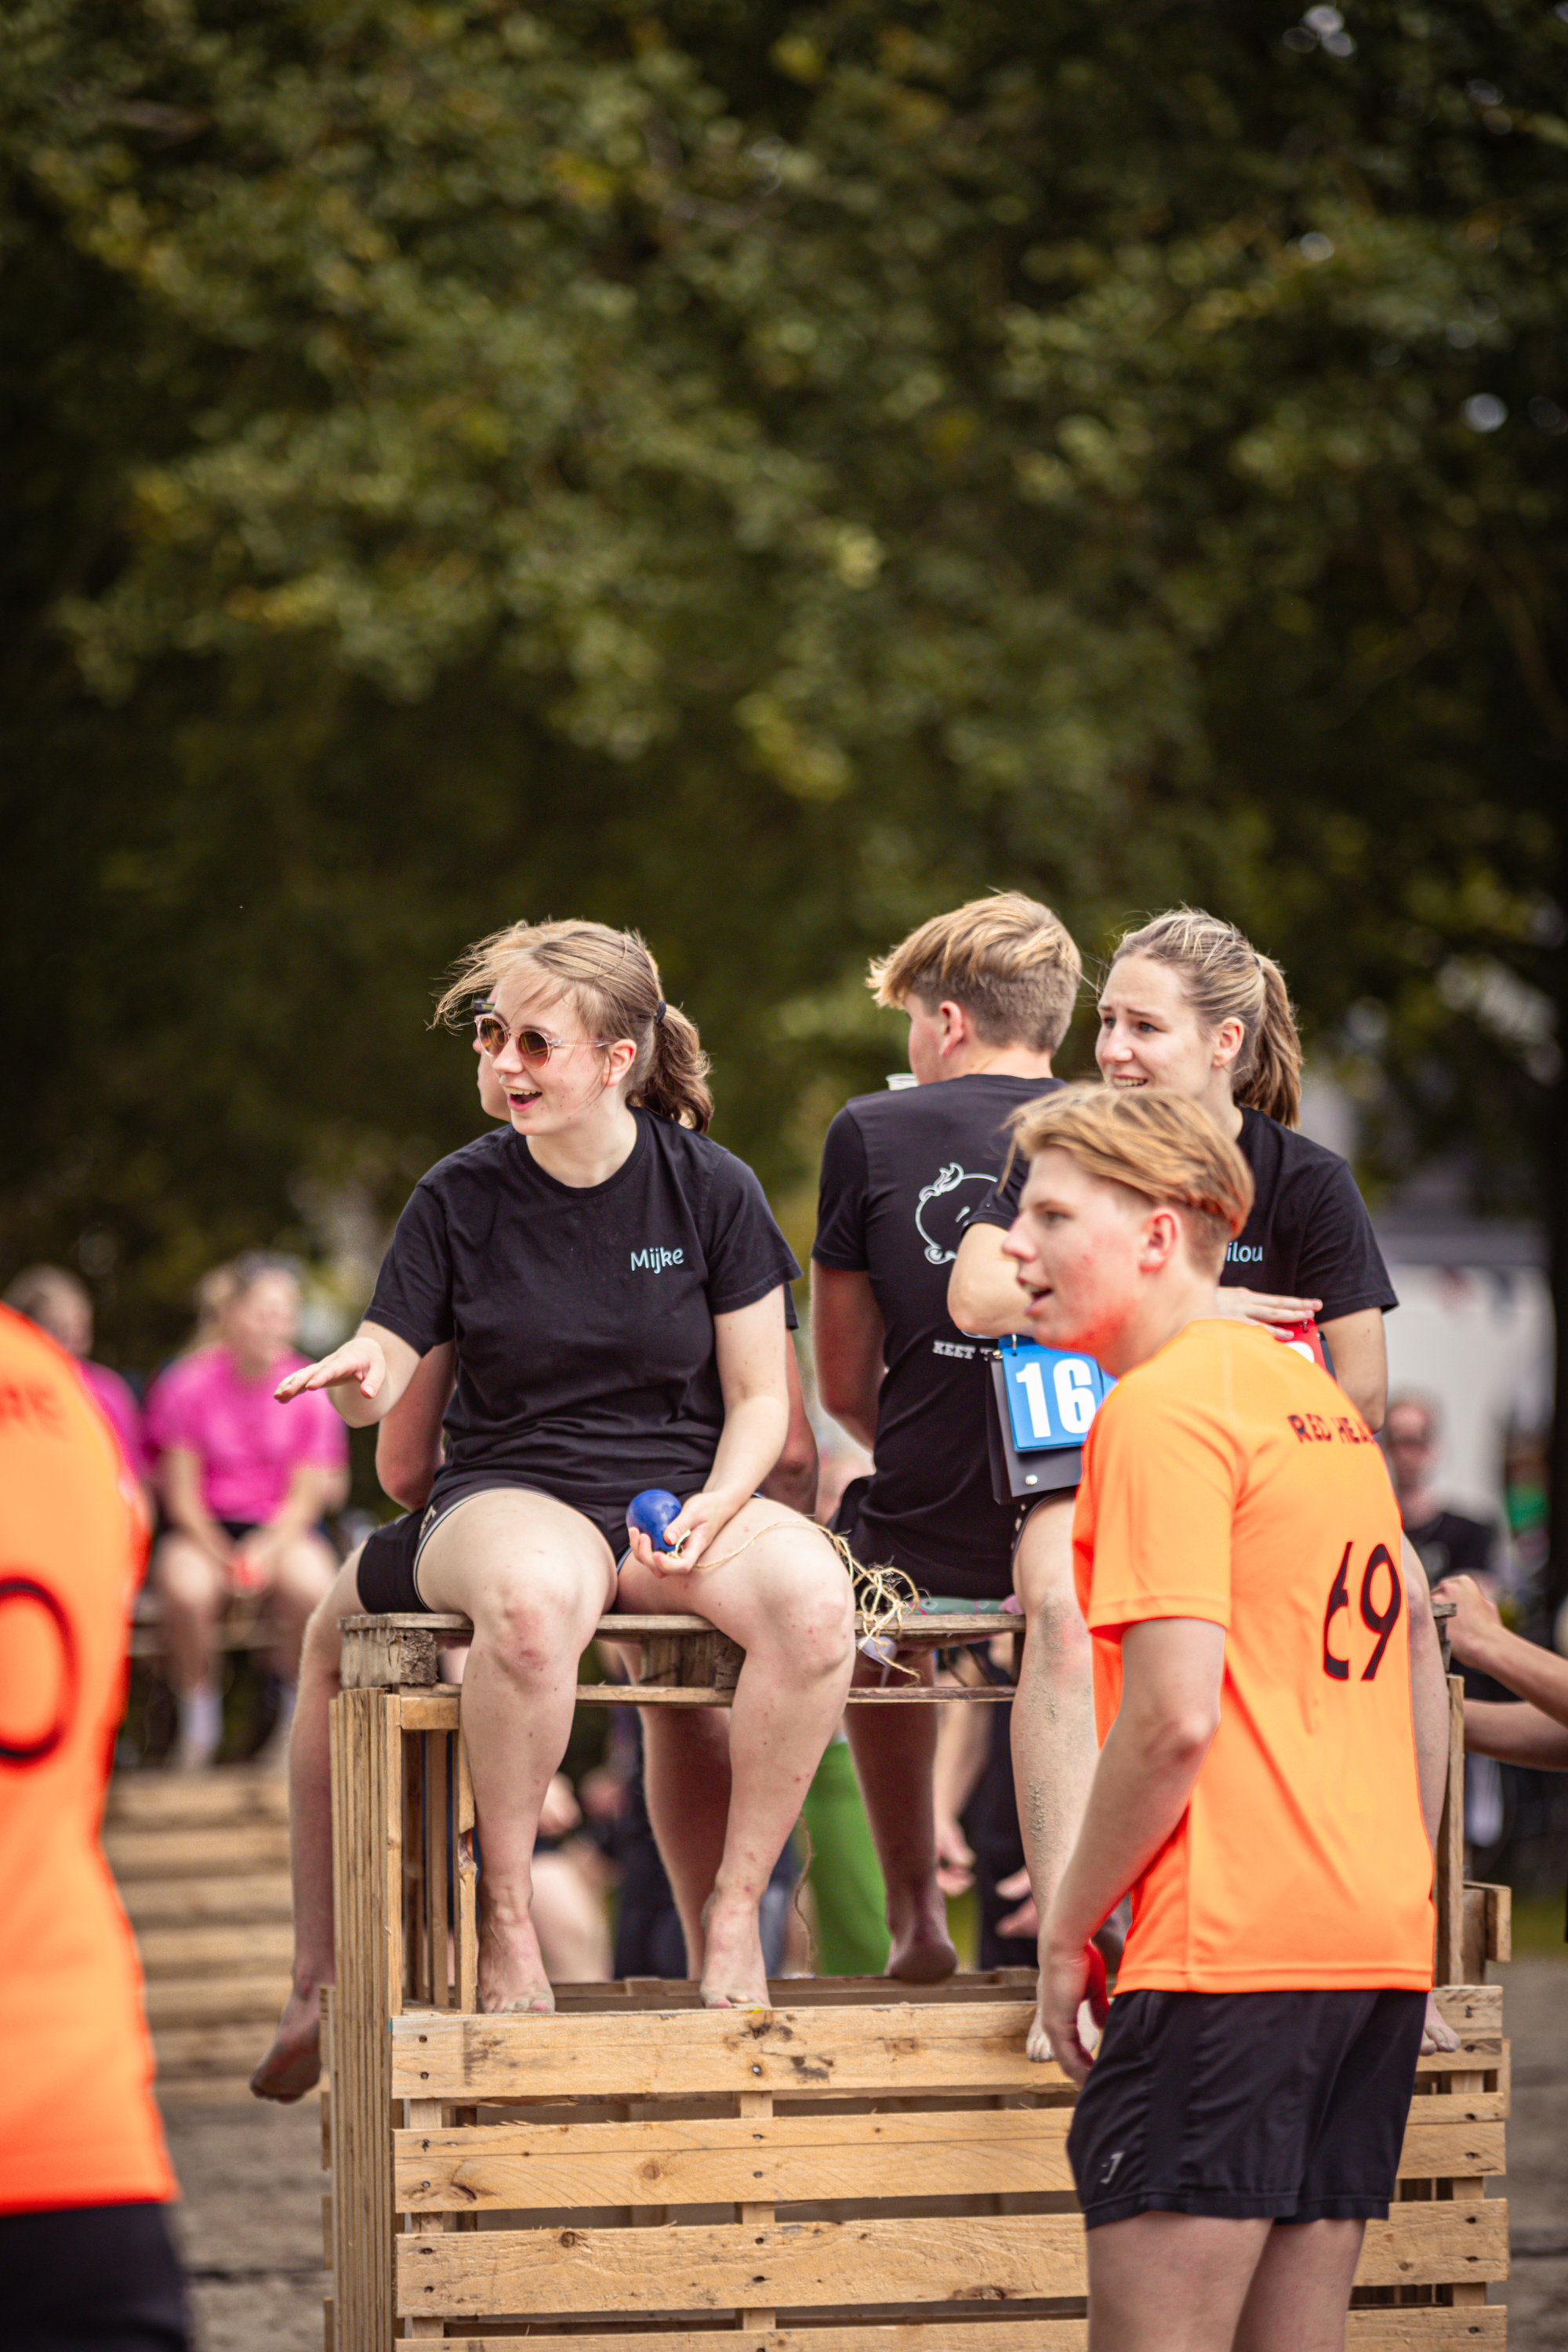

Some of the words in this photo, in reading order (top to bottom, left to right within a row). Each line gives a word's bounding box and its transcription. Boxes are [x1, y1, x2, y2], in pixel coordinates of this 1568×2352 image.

[630, 1246, 684, 1274] Mijke
[1225, 1240, 1263, 1262] ilou
[932, 1339, 976, 1360] KEET
[1015, 1358, 1097, 1439] 16
[1287, 1413, 1332, 1444] RED
[1330, 1416, 1375, 1445] HEA
[1323, 1541, 1402, 1682] 69
